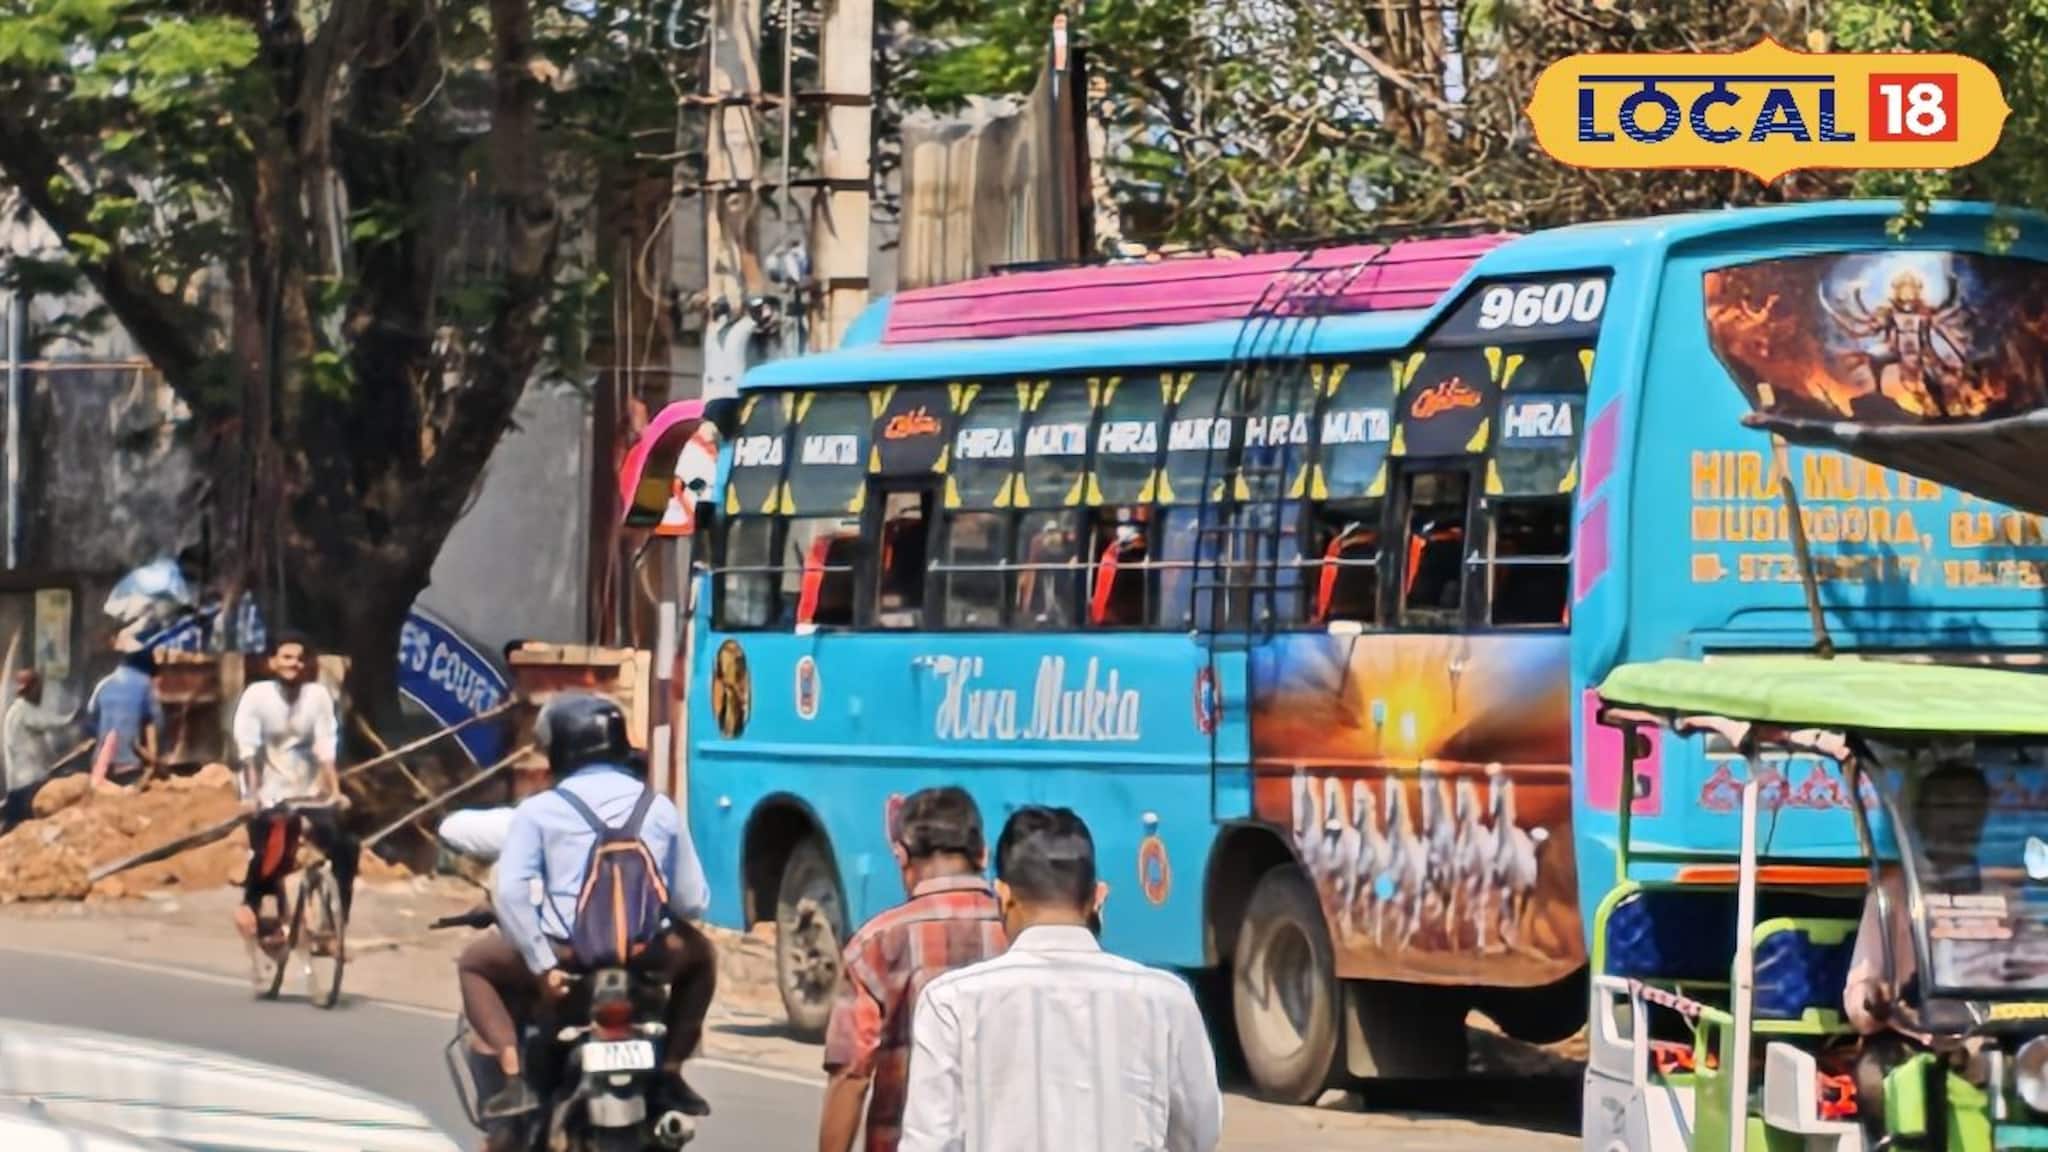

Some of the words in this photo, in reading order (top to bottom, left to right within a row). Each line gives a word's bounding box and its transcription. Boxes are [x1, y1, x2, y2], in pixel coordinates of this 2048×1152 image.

[1478, 278, 1606, 330] 9600
[1097, 422, 1158, 453] HIRA
[1244, 412, 1308, 447] HRA
[1504, 402, 1573, 438] HIRA
[956, 428, 1014, 458] HIRA
[1692, 450, 1787, 499] HIRA
